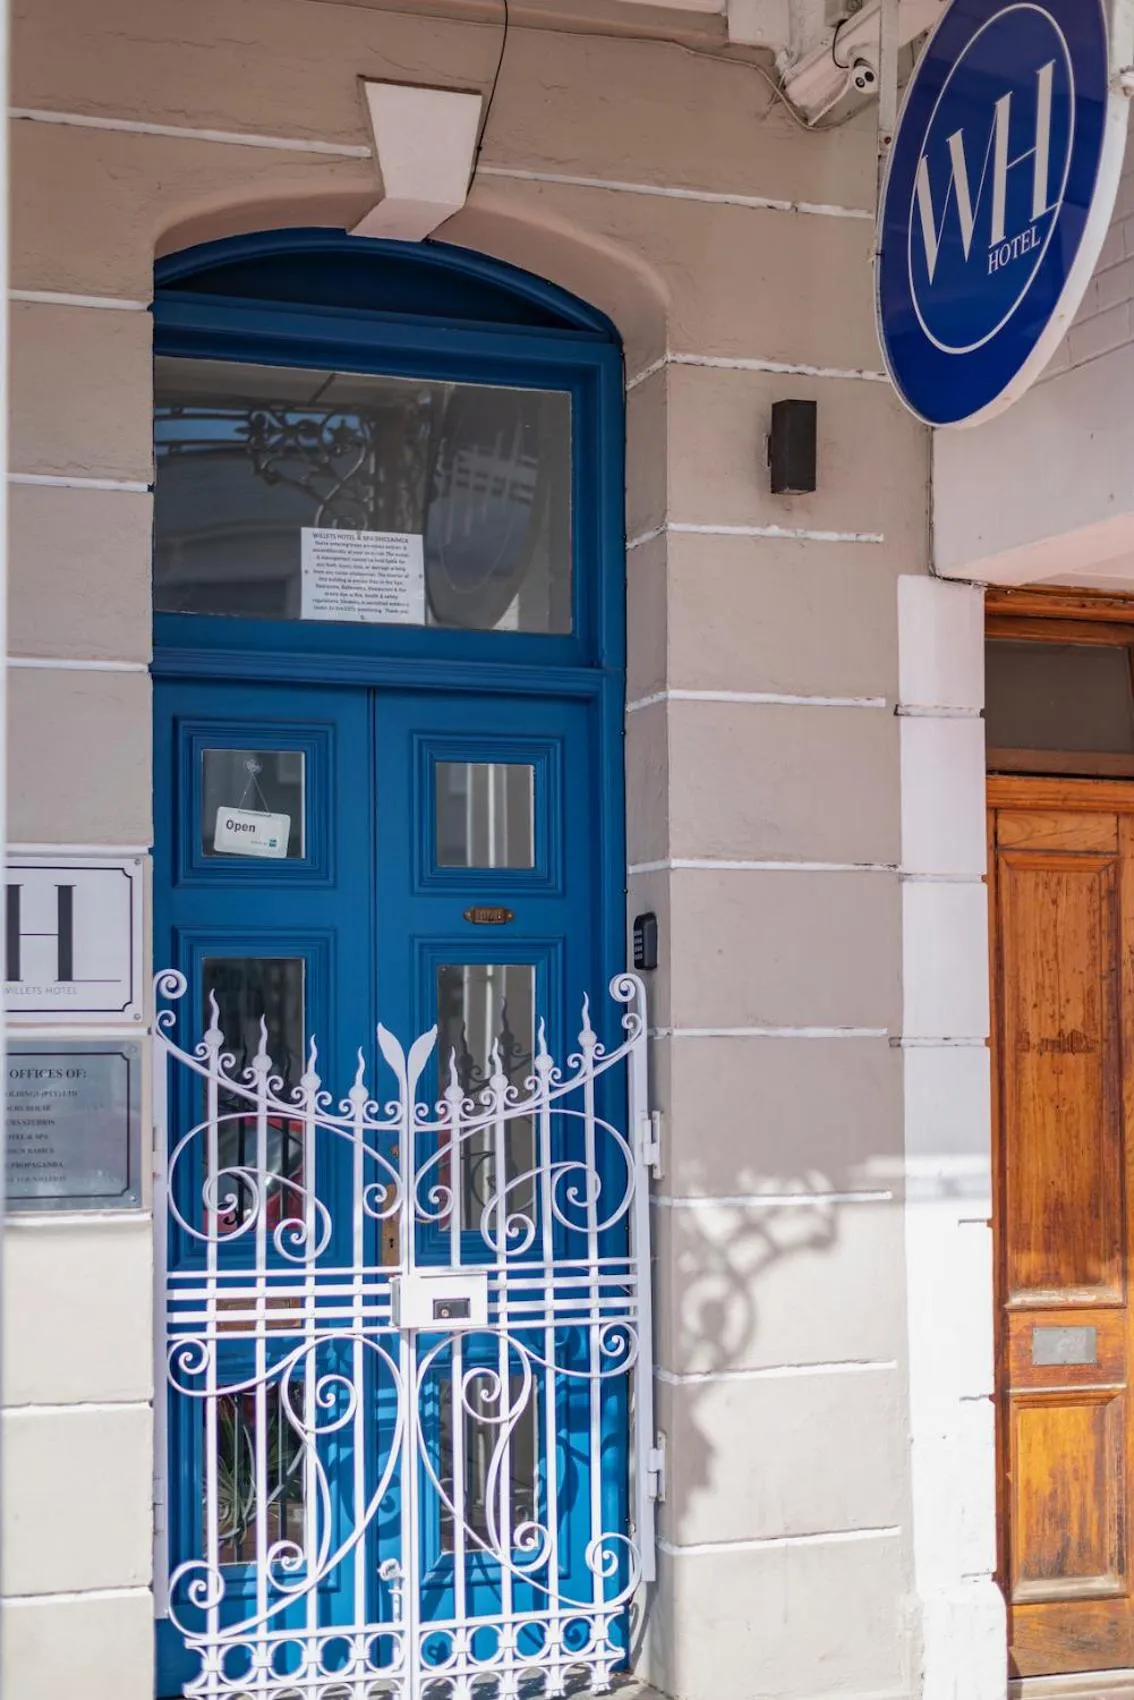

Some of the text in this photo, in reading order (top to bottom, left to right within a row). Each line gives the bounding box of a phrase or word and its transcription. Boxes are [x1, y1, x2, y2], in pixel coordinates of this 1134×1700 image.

[915, 59, 1060, 286] WH
[987, 225, 1041, 275] HOTEL
[226, 819, 256, 833] Open
[45, 986, 78, 995] HOTEL
[9, 1069, 87, 1079] OFFICES OF:
